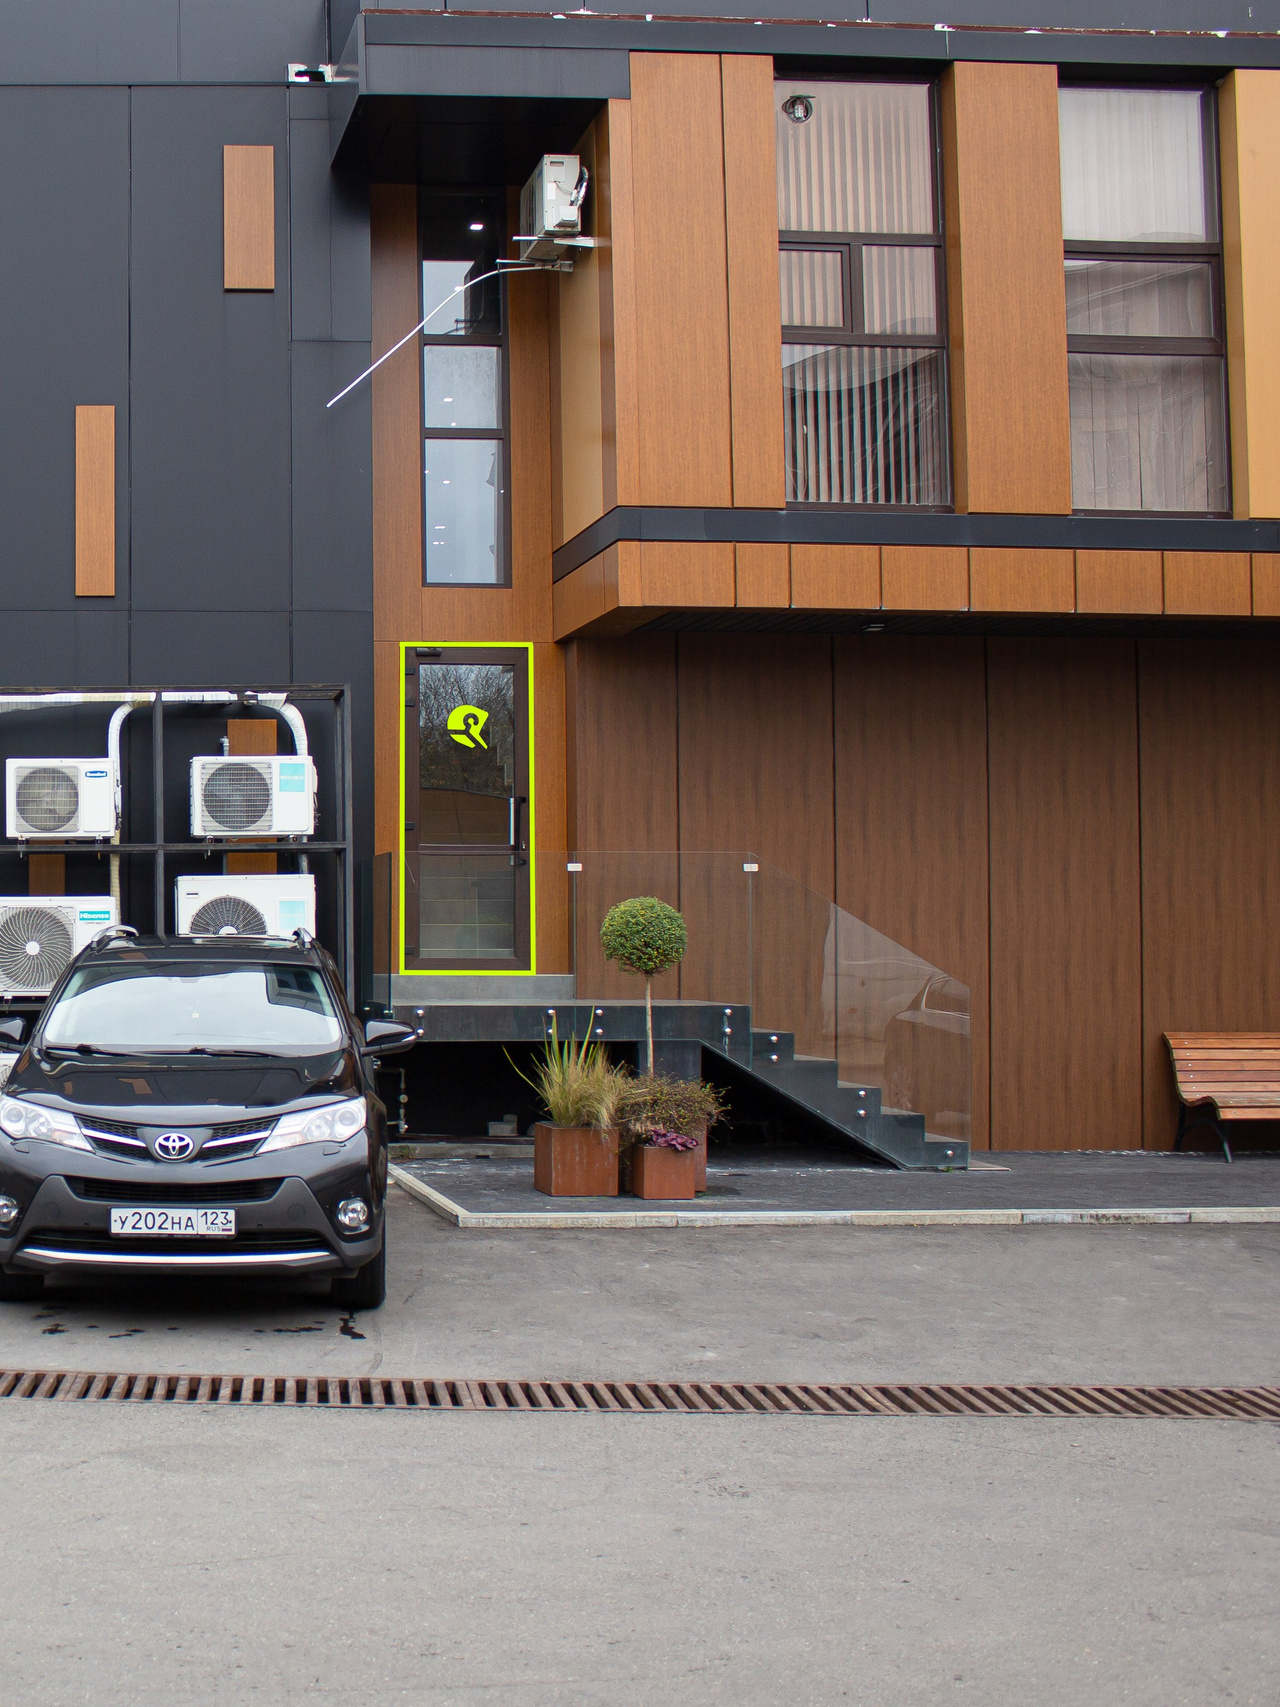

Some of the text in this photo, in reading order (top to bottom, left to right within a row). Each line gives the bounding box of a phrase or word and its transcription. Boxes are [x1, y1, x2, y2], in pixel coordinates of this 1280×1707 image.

[118, 1211, 229, 1231] У202НА 123
[206, 1224, 221, 1232] RUS
